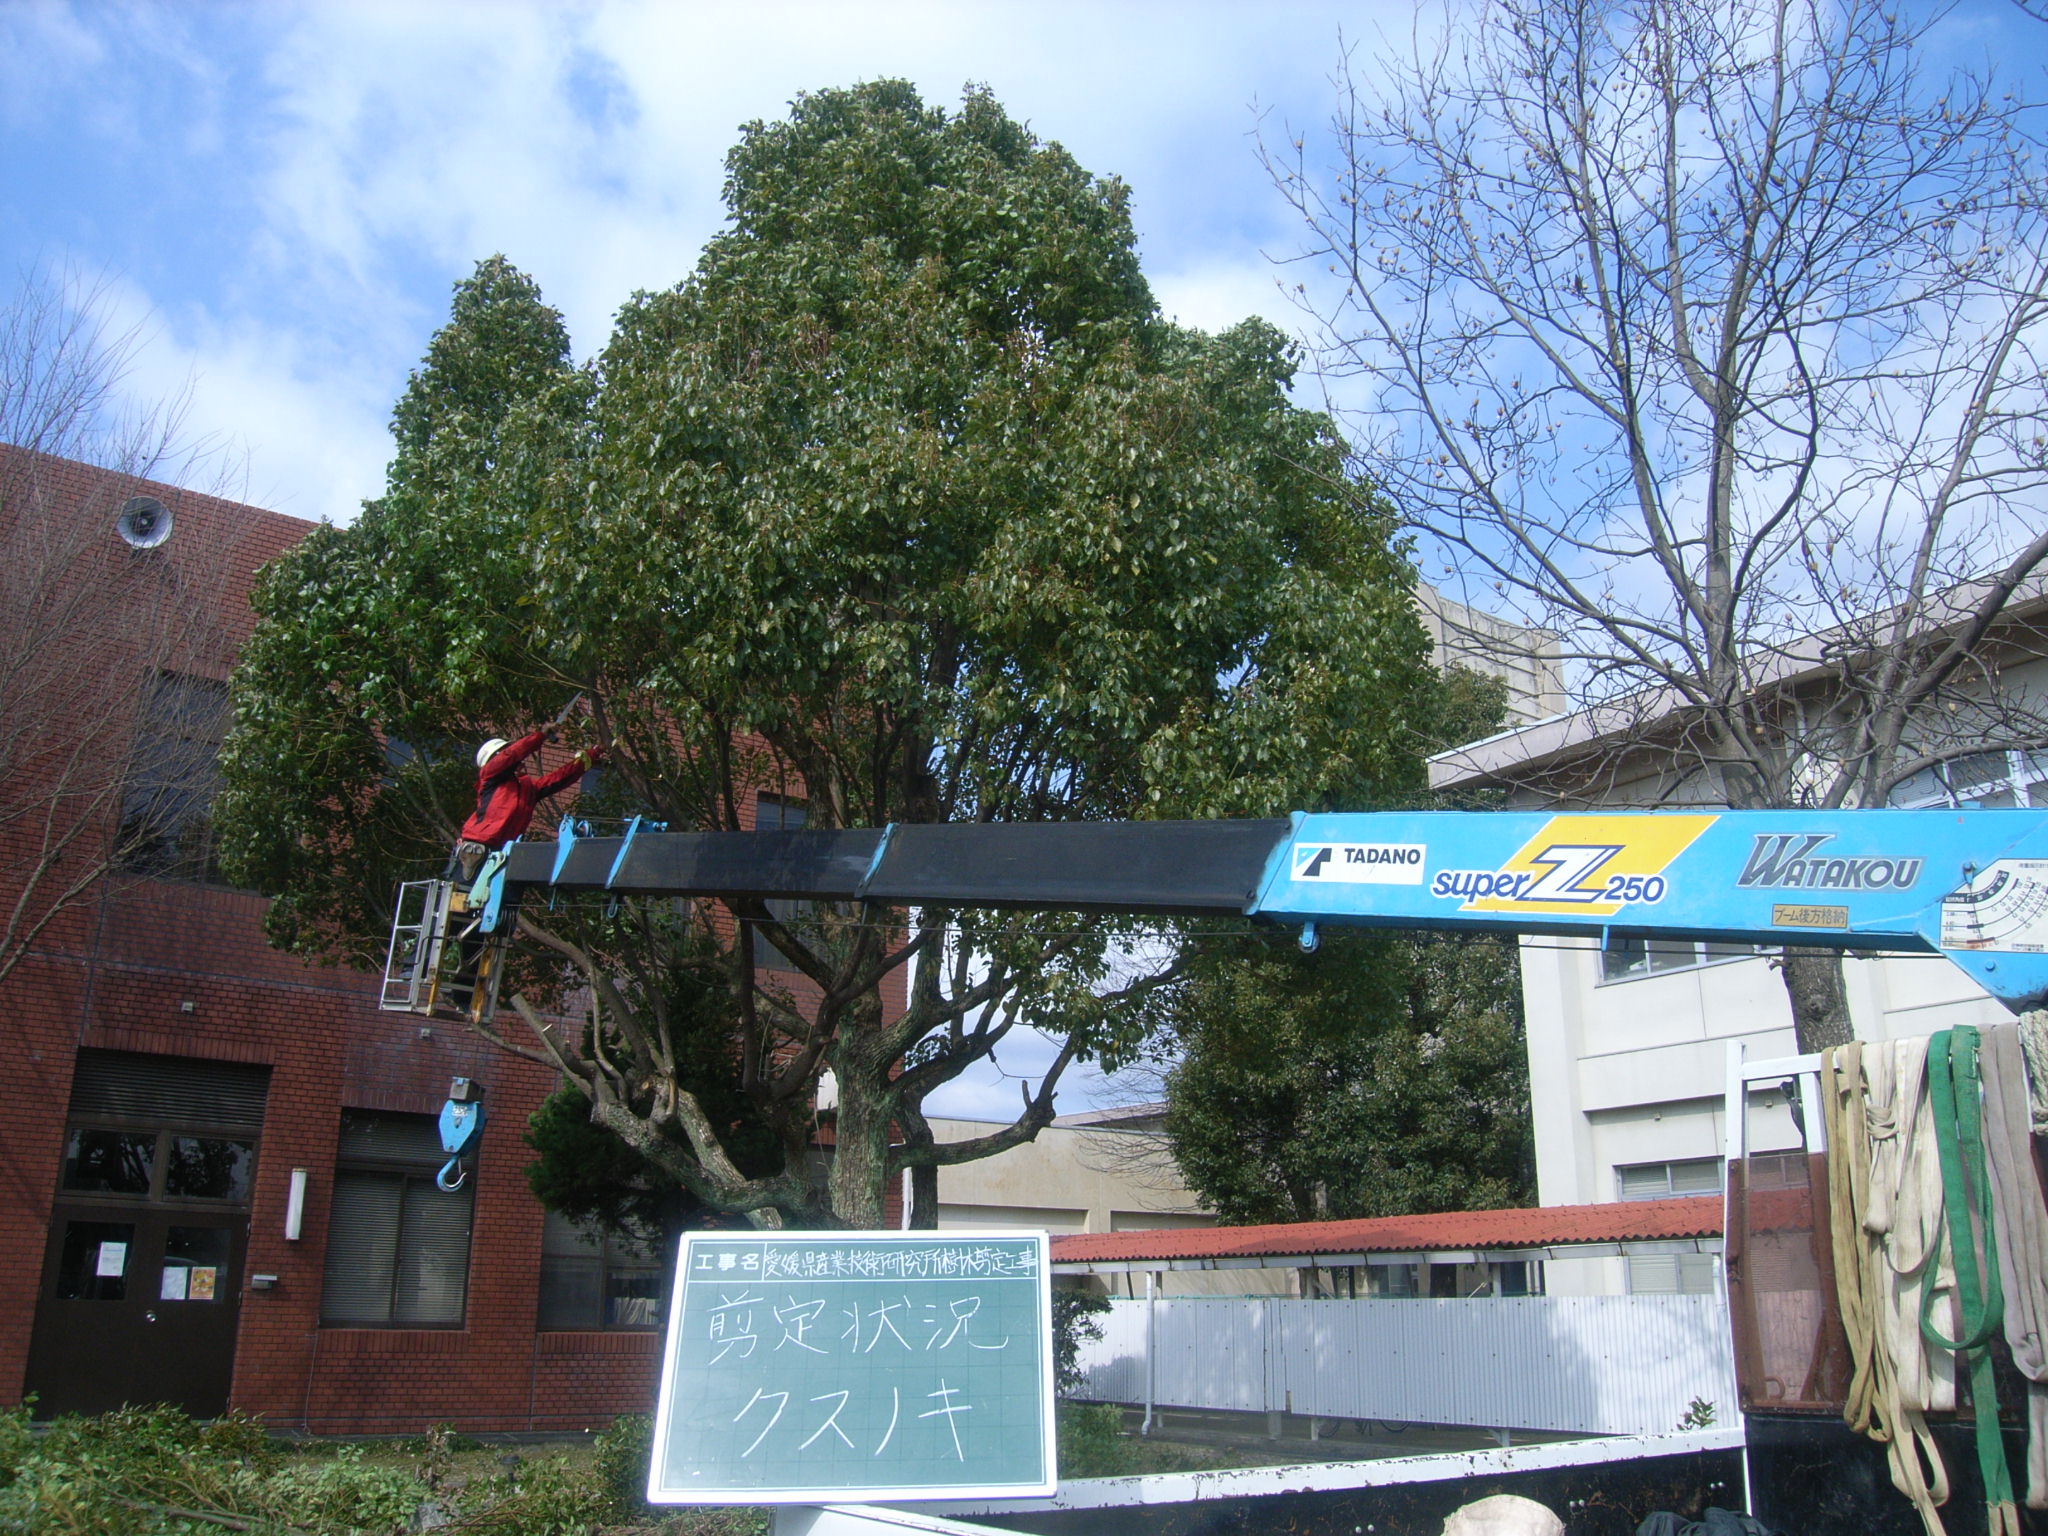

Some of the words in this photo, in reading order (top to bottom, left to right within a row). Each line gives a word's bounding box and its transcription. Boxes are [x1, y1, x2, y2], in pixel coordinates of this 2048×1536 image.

[1344, 848, 1421, 865] TADANO
[1737, 833, 1923, 888] WATAKOU
[695, 1253, 760, 1271] 工事名
[707, 1290, 1009, 1366] 剪定状況
[733, 1378, 973, 1462] クスノキ
